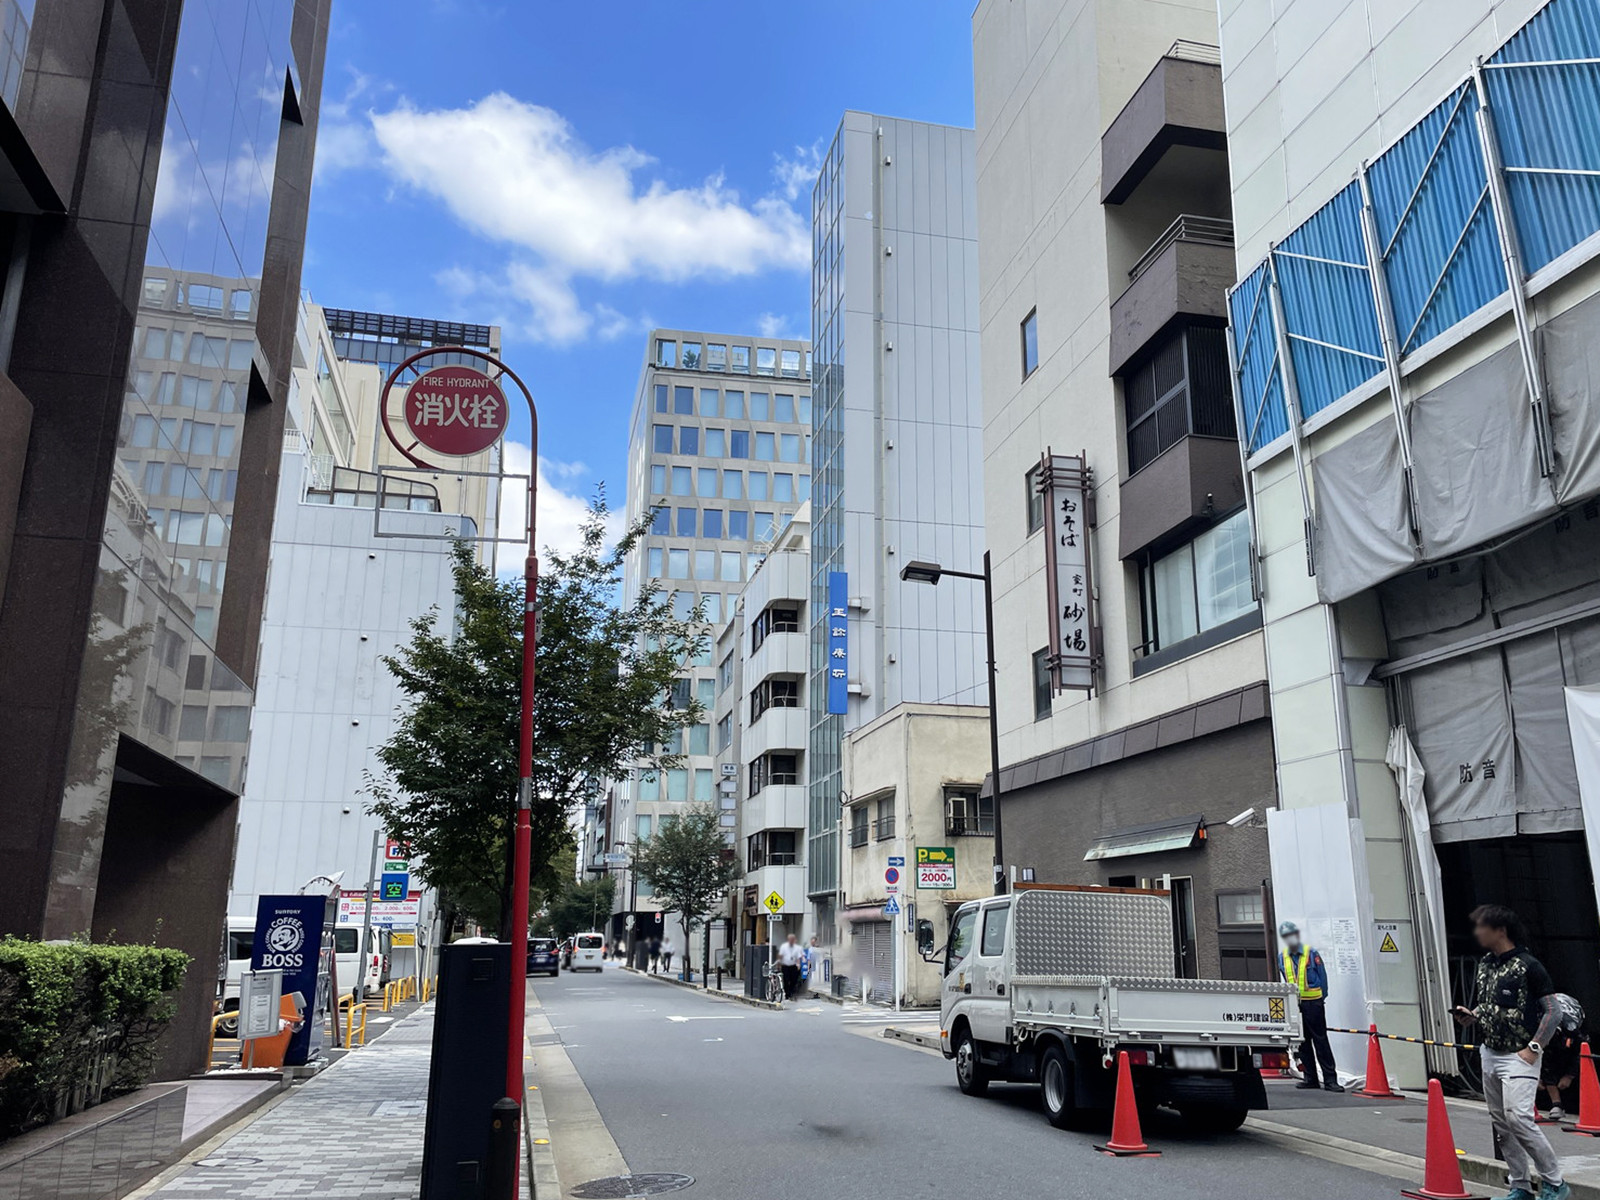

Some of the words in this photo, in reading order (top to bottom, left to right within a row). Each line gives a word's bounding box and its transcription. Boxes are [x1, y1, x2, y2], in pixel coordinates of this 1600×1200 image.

[422, 376, 444, 387] FIRE
[446, 377, 490, 389] HYDRANT
[414, 391, 500, 429] 消火栓
[1060, 497, 1080, 548] おそば
[1072, 573, 1084, 597] 室町
[1062, 602, 1087, 652] 砂場
[1459, 758, 1496, 785] 防音
[921, 872, 952, 883] 2000円
[386, 882, 403, 898] 空
[271, 916, 303, 929] COFFEE
[261, 953, 304, 968] BOSS
